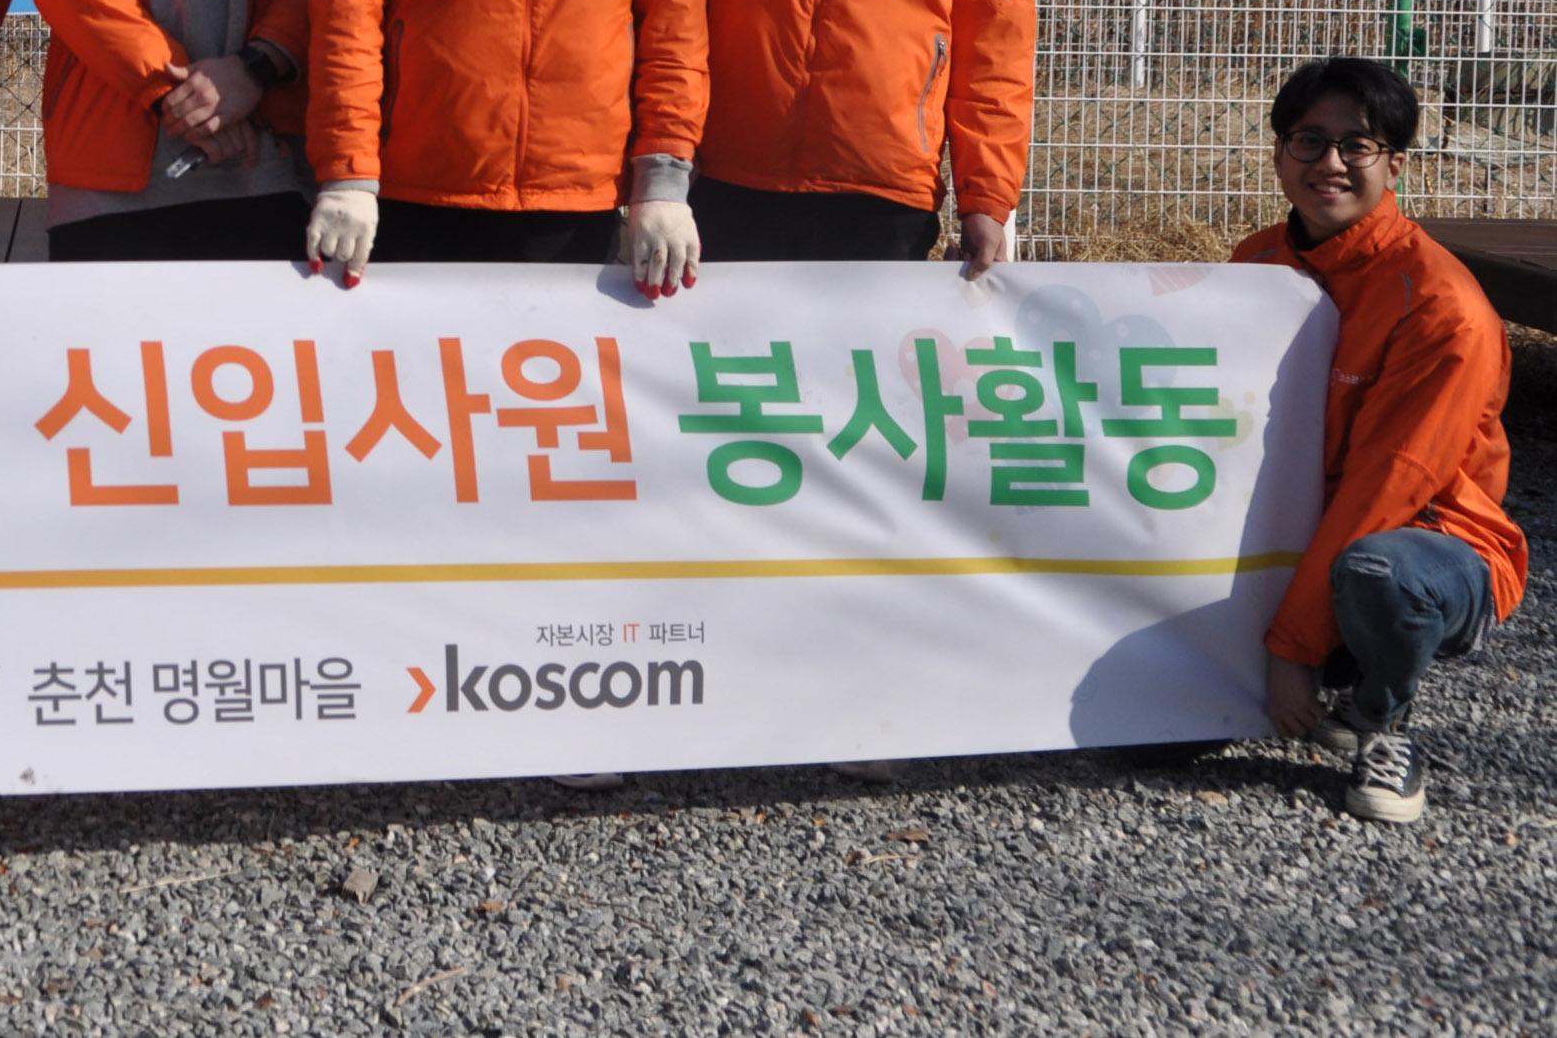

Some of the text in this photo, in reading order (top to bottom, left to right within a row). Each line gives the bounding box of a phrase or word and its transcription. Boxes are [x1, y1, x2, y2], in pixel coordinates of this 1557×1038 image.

[37, 339, 636, 504] 신입사원
[681, 340, 1236, 510] 봉사활동
[535, 621, 706, 647] 자본시장 IT 파트너
[28, 661, 133, 726] 춘천
[153, 658, 361, 725] 명월마을
[445, 644, 705, 713] koscom
